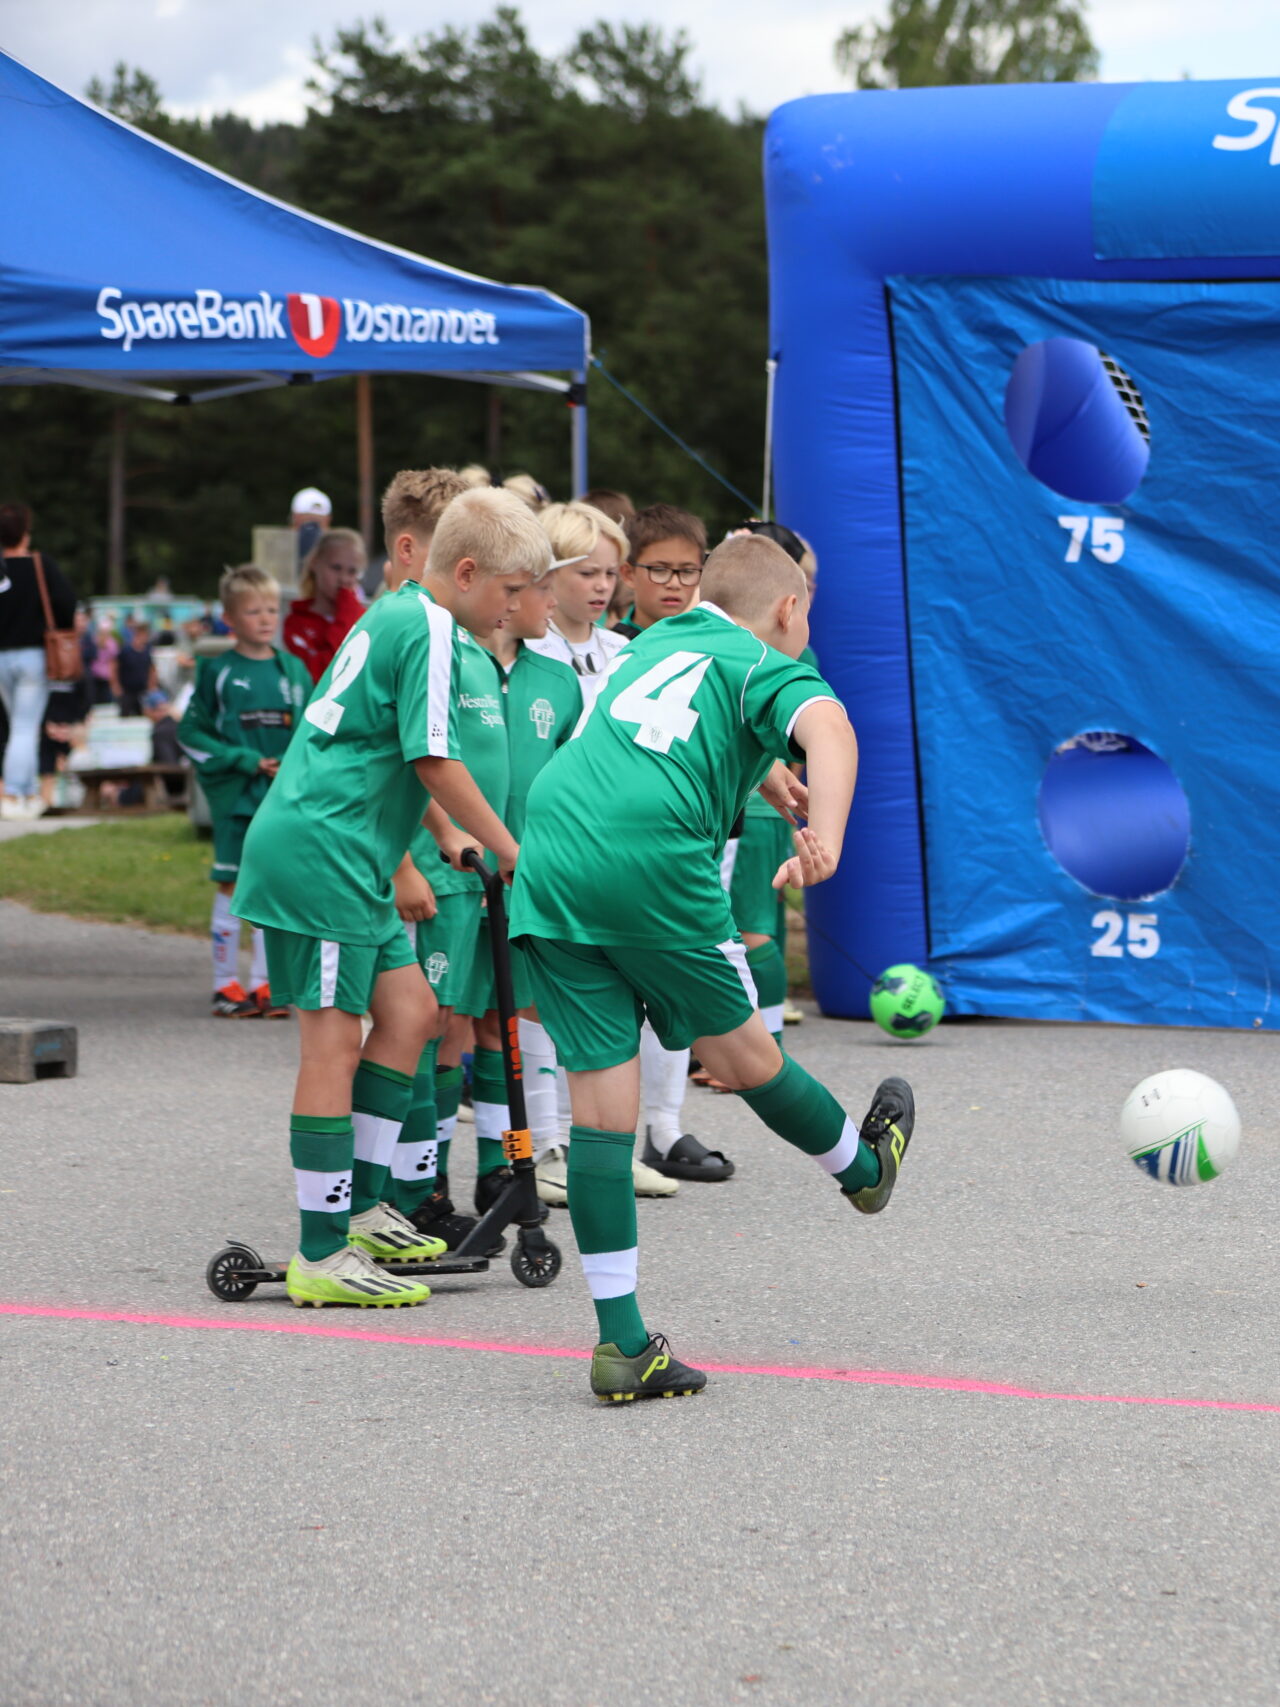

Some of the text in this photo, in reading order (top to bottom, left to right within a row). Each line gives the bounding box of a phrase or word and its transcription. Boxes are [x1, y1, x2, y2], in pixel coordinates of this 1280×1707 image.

[97, 287, 287, 351] SpareBank
[300, 293, 324, 340] 1
[1058, 515, 1125, 564] 75
[1091, 910, 1160, 959] 25
